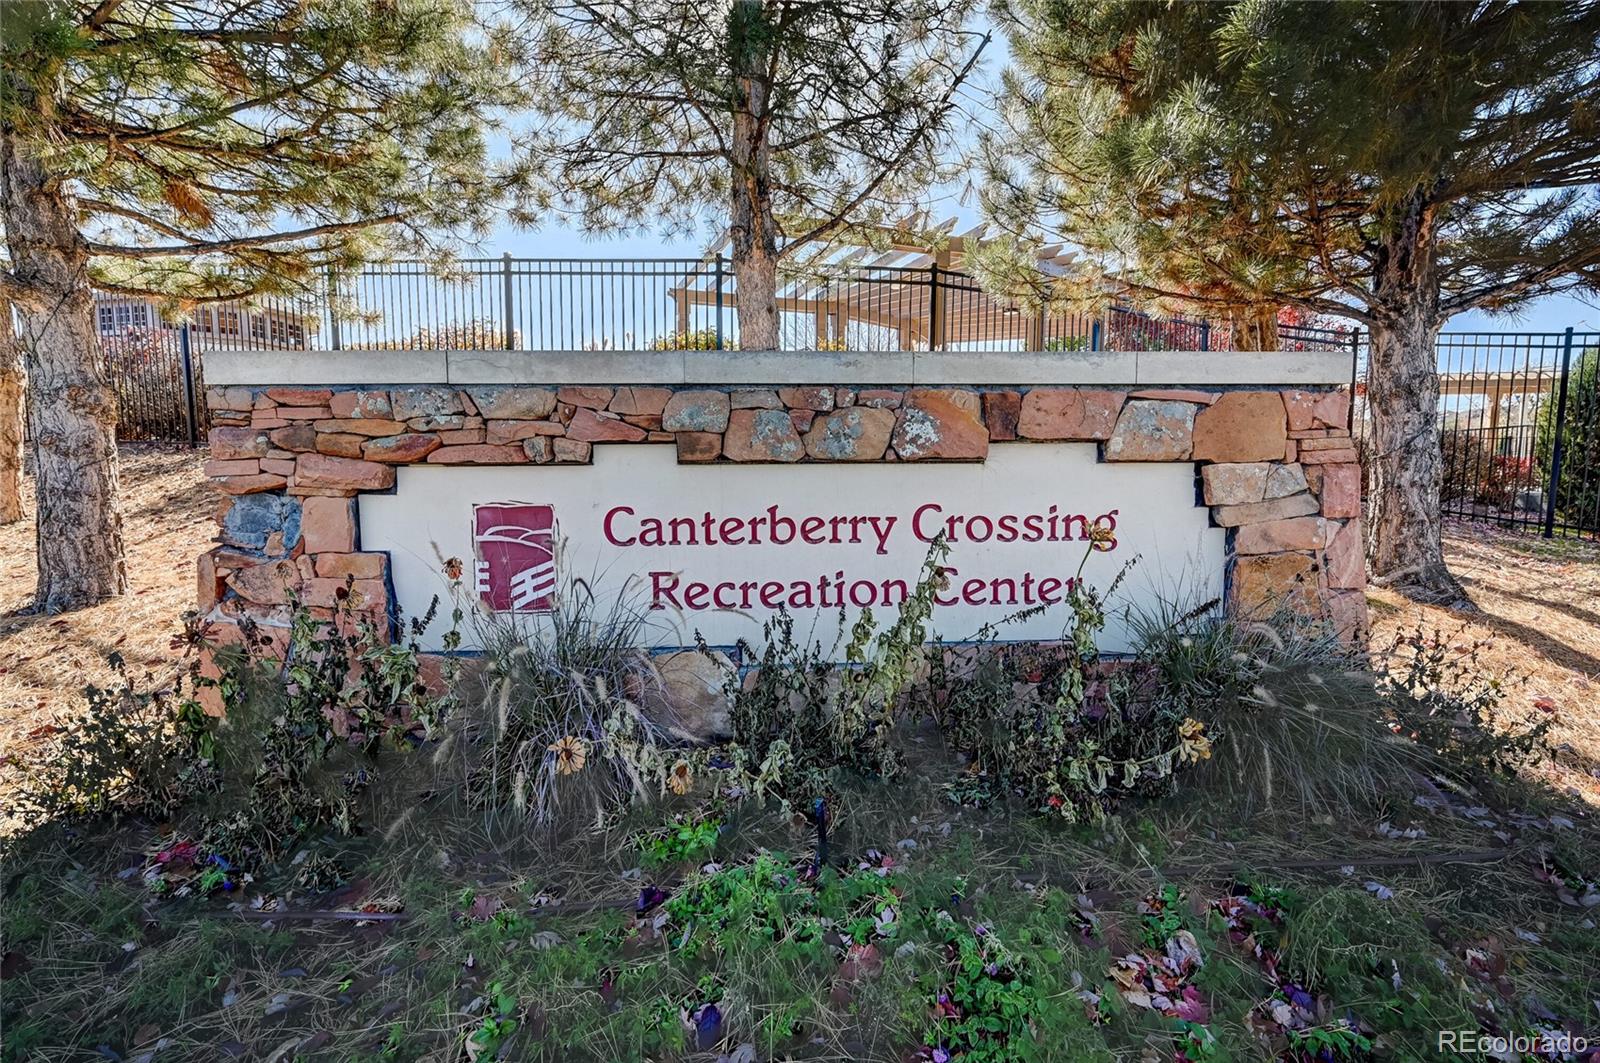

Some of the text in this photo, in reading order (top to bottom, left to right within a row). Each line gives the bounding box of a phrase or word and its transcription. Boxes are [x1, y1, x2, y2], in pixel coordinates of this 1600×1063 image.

[602, 503, 1118, 554] Canterberry Crossing
[648, 570, 908, 611] Recreation
